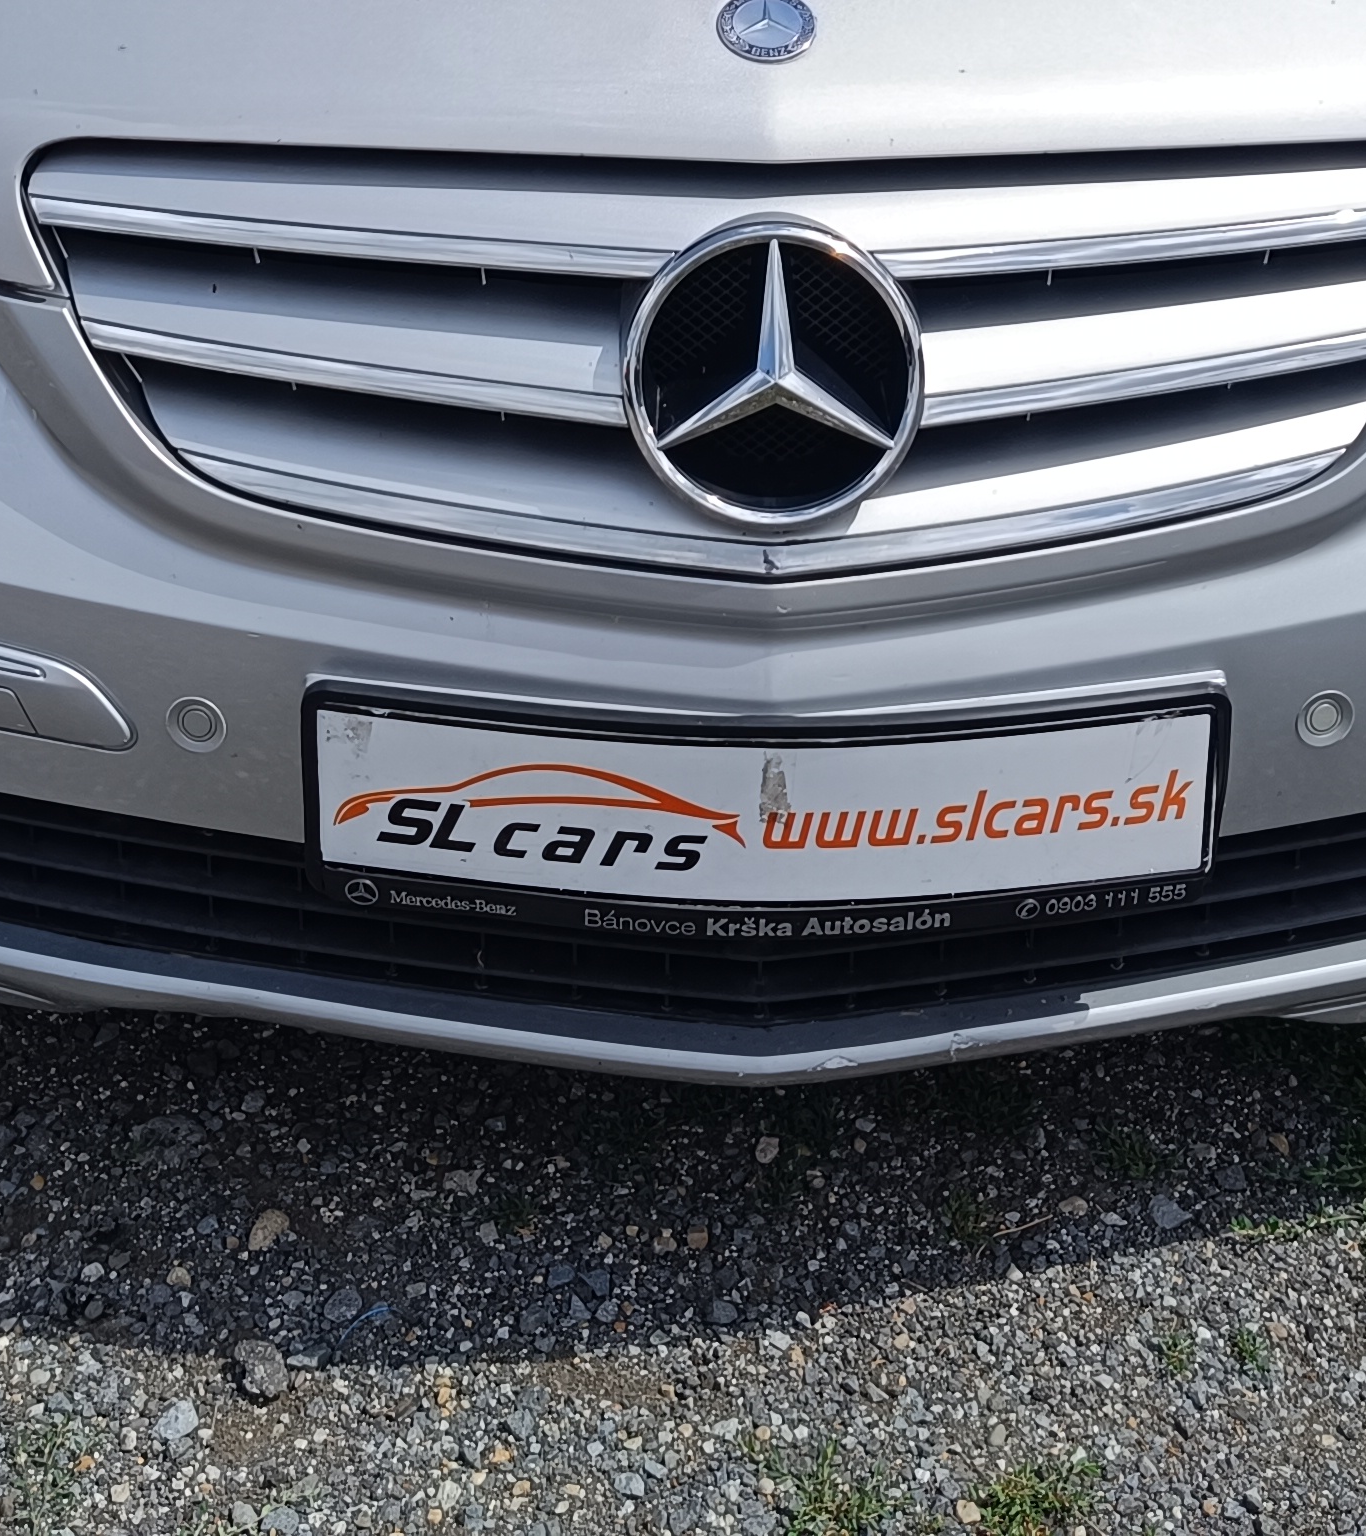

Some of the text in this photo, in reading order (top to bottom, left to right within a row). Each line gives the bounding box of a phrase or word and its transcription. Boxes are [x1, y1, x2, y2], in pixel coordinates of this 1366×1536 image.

[750, 46, 789, 58] BENZ
[762, 768, 1194, 850] www.slcars.sk
[389, 890, 517, 916] Mercedes-Benz
[1045, 883, 1187, 915] 0903 111 555
[584, 908, 952, 937] Bánovce Krška Autosalón
